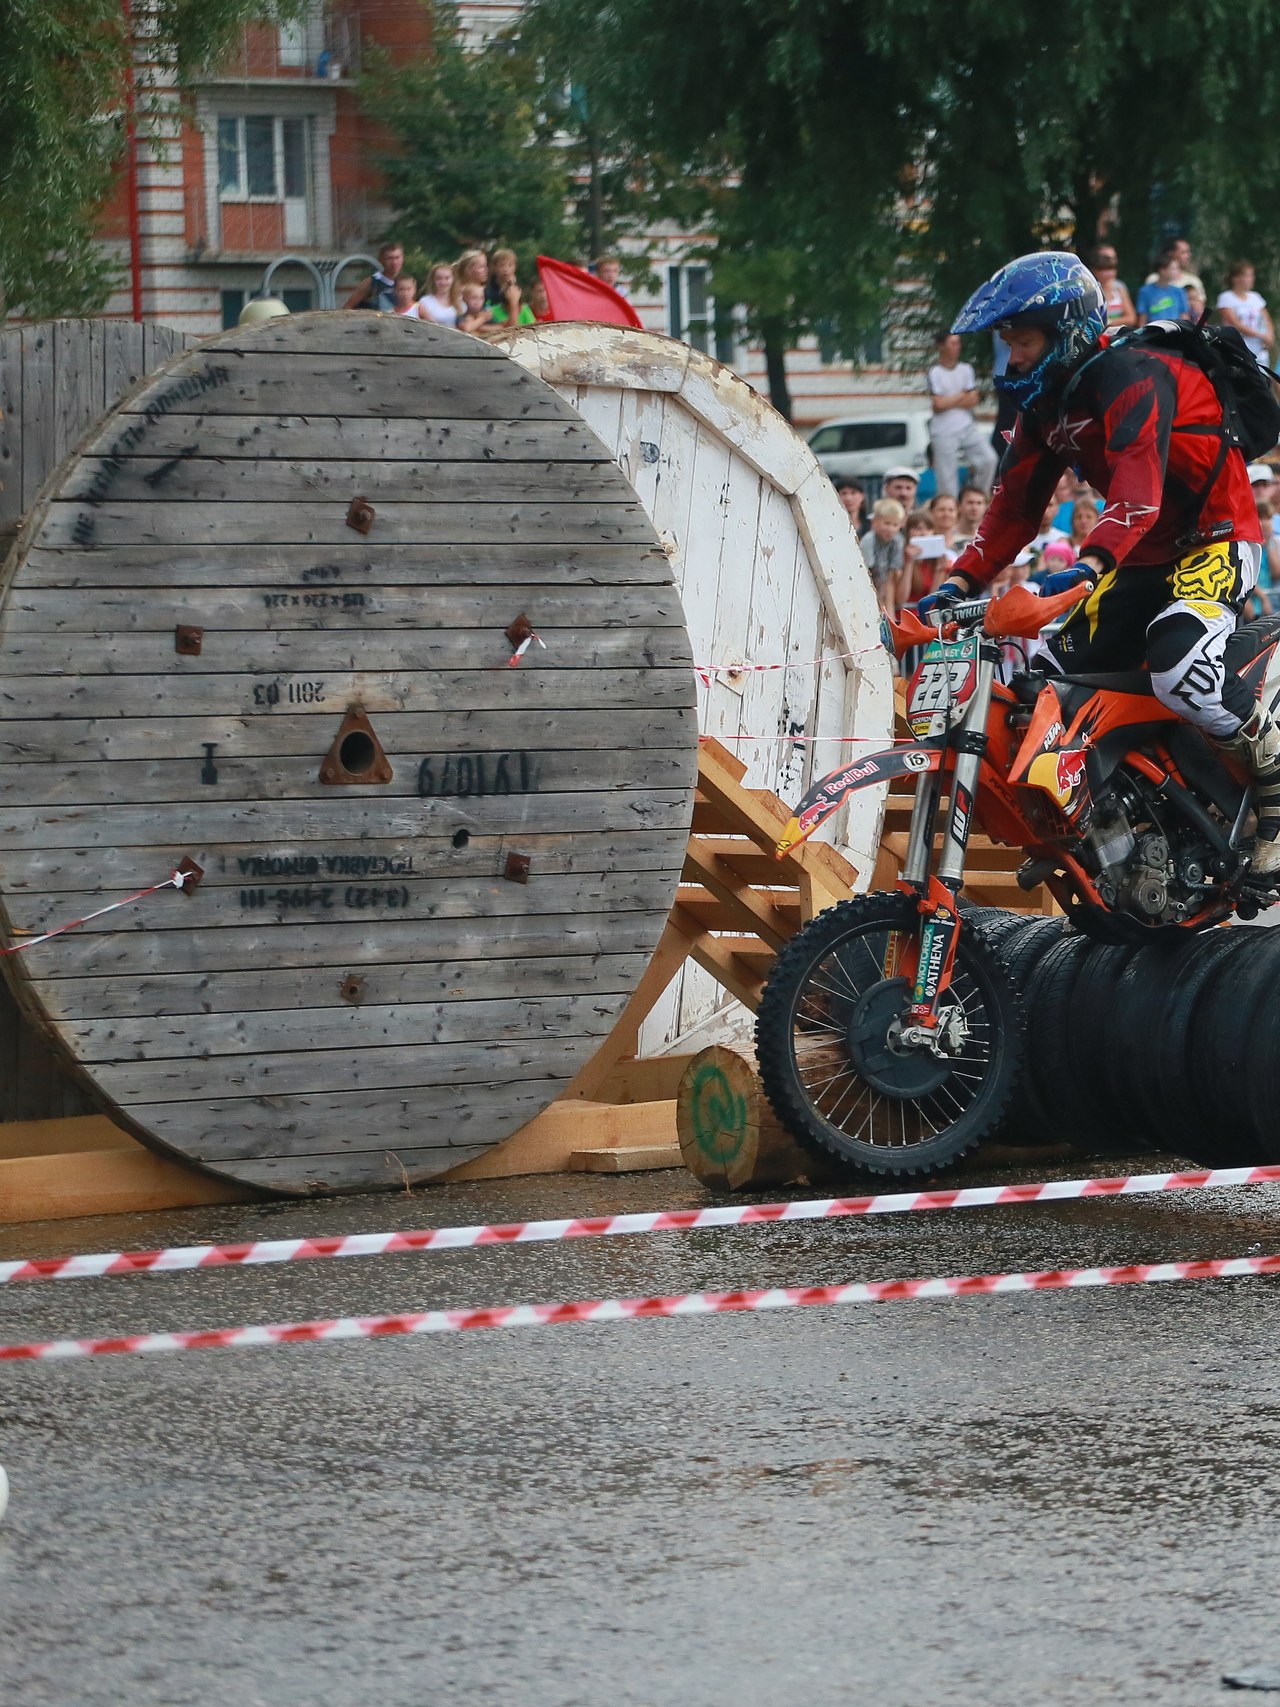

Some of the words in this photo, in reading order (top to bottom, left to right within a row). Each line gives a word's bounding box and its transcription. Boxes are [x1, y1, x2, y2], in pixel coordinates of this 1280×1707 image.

[909, 661, 972, 714] 222
[1168, 630, 1227, 712] FOX
[1043, 722, 1062, 751] KTM
[952, 789, 969, 842] WP
[916, 928, 935, 985] MOTOREX
[926, 933, 946, 985] ATHENA
